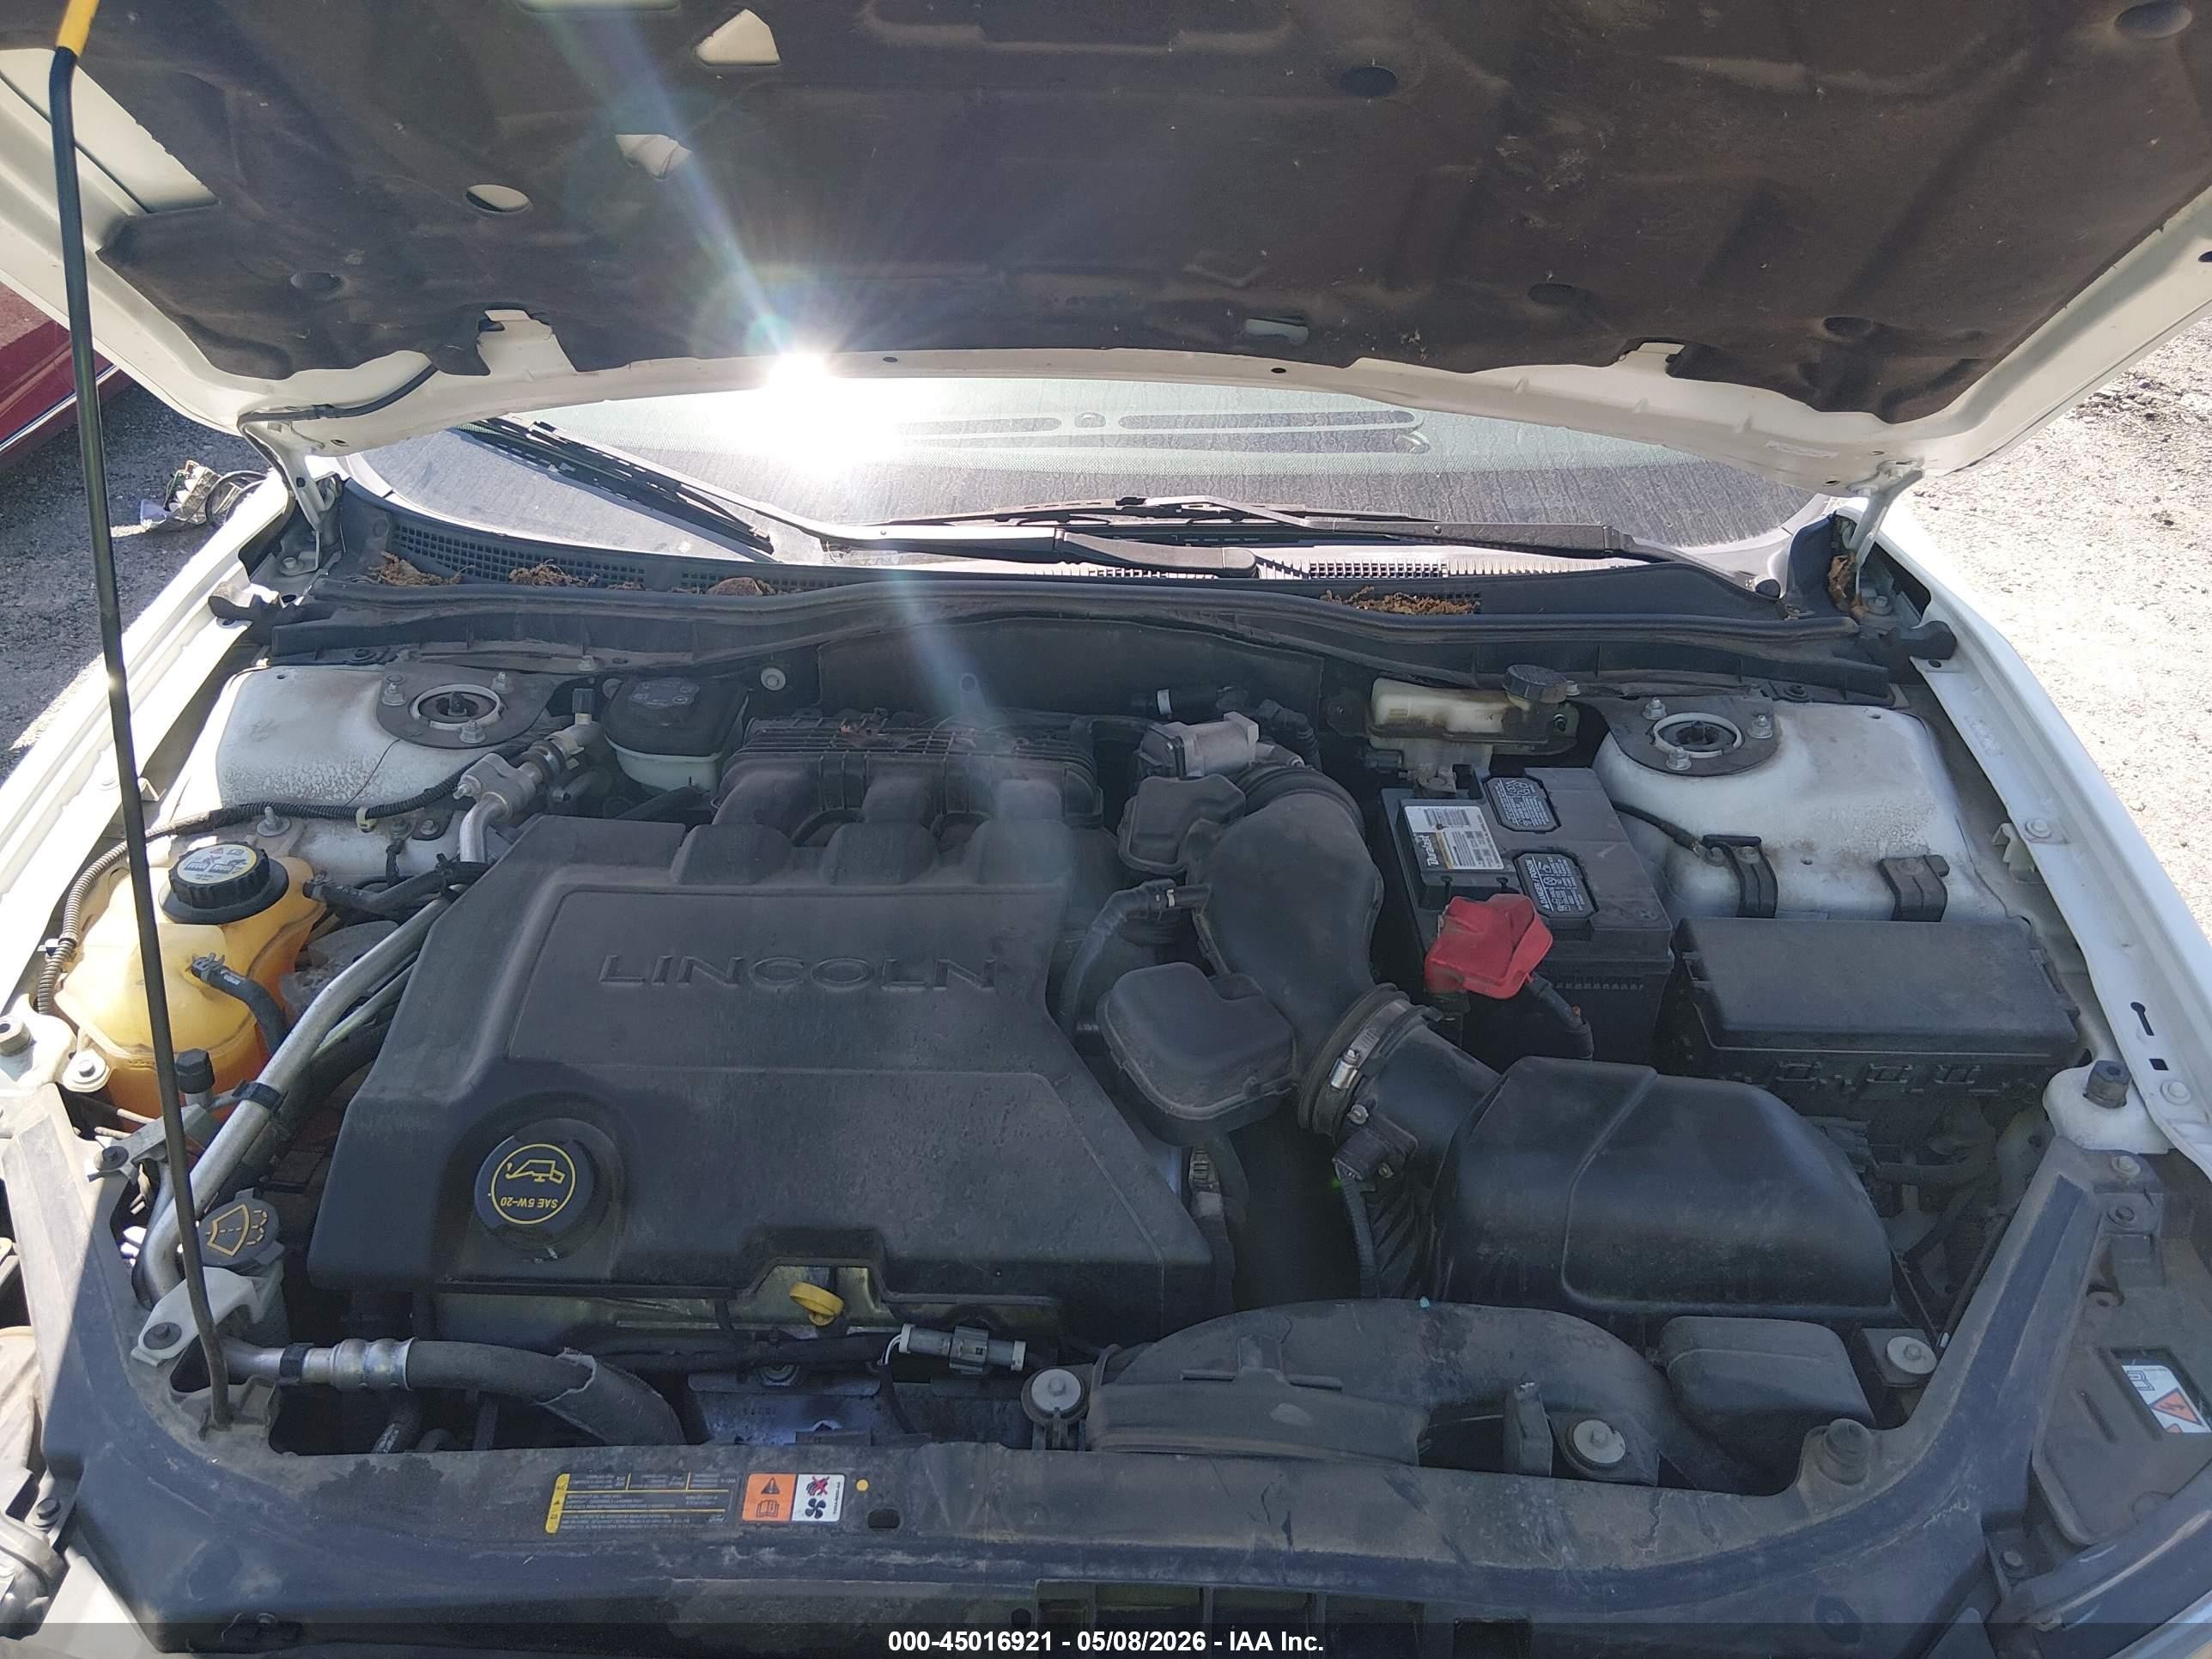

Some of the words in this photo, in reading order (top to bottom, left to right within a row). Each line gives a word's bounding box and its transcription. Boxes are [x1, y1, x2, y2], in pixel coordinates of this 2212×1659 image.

[1419, 835, 1439, 866] Duralast
[599, 953, 996, 992] LINCOLN
[500, 1196, 536, 1209] 5W-20
[537, 1197, 559, 1209] SAE
